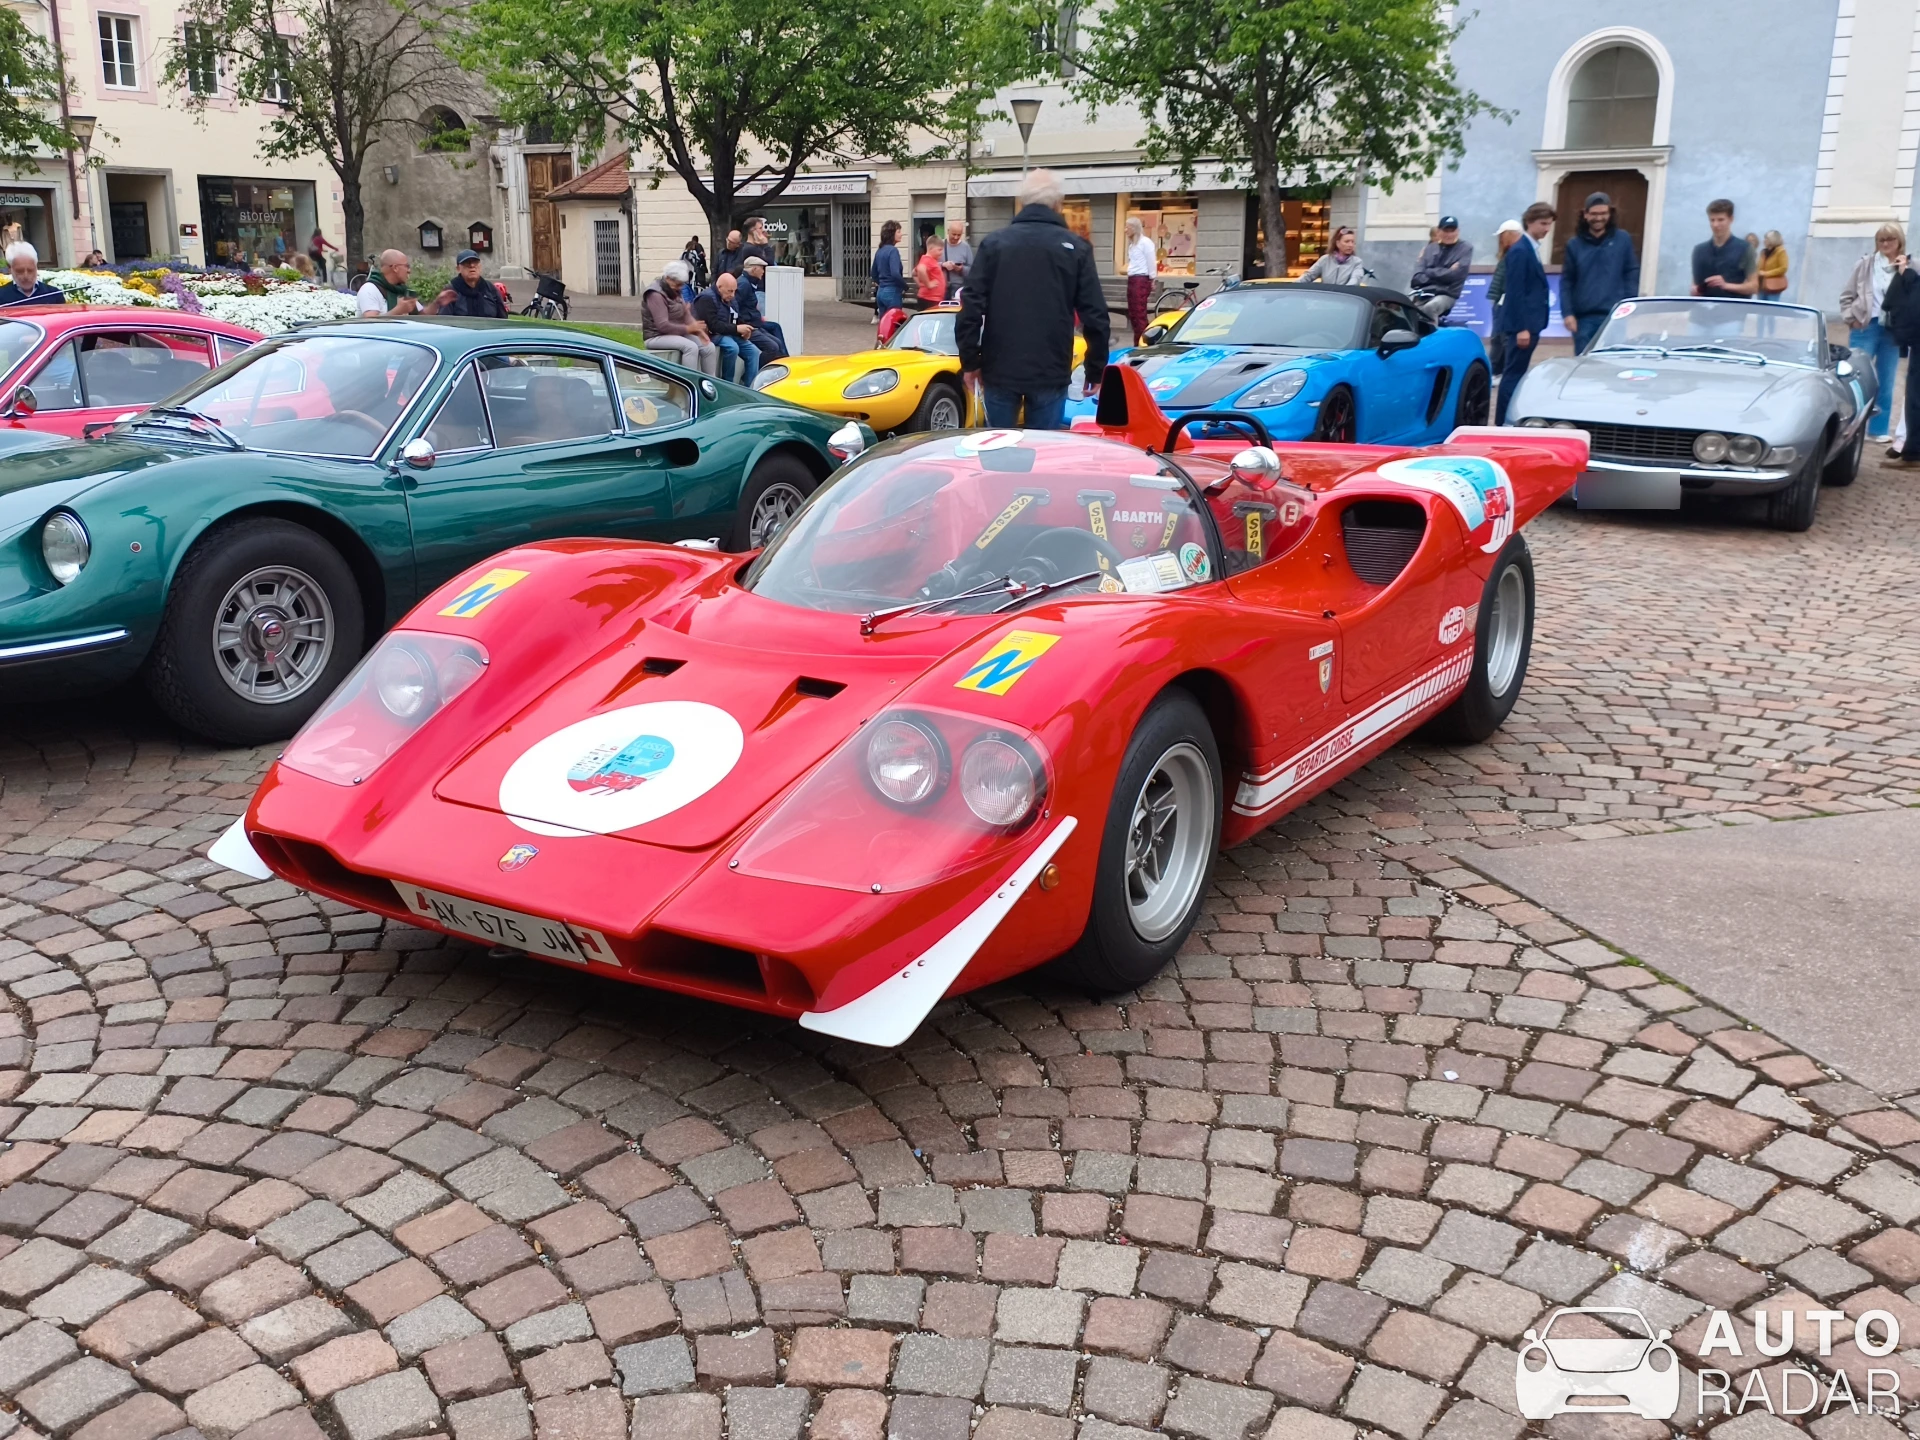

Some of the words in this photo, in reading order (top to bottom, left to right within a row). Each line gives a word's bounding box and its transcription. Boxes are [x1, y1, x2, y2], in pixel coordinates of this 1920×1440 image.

[824, 184, 854, 192] BAMBINI
[1124, 177, 1168, 187] LUTTEI
[0, 194, 30, 205] globus
[980, 497, 1029, 543] Sabelt
[1112, 511, 1163, 524] ABARTH
[1284, 505, 1296, 522] E
[1293, 745, 1329, 783] REPARTO
[1329, 728, 1355, 758] CORSE
[542, 927, 576, 955] JW
